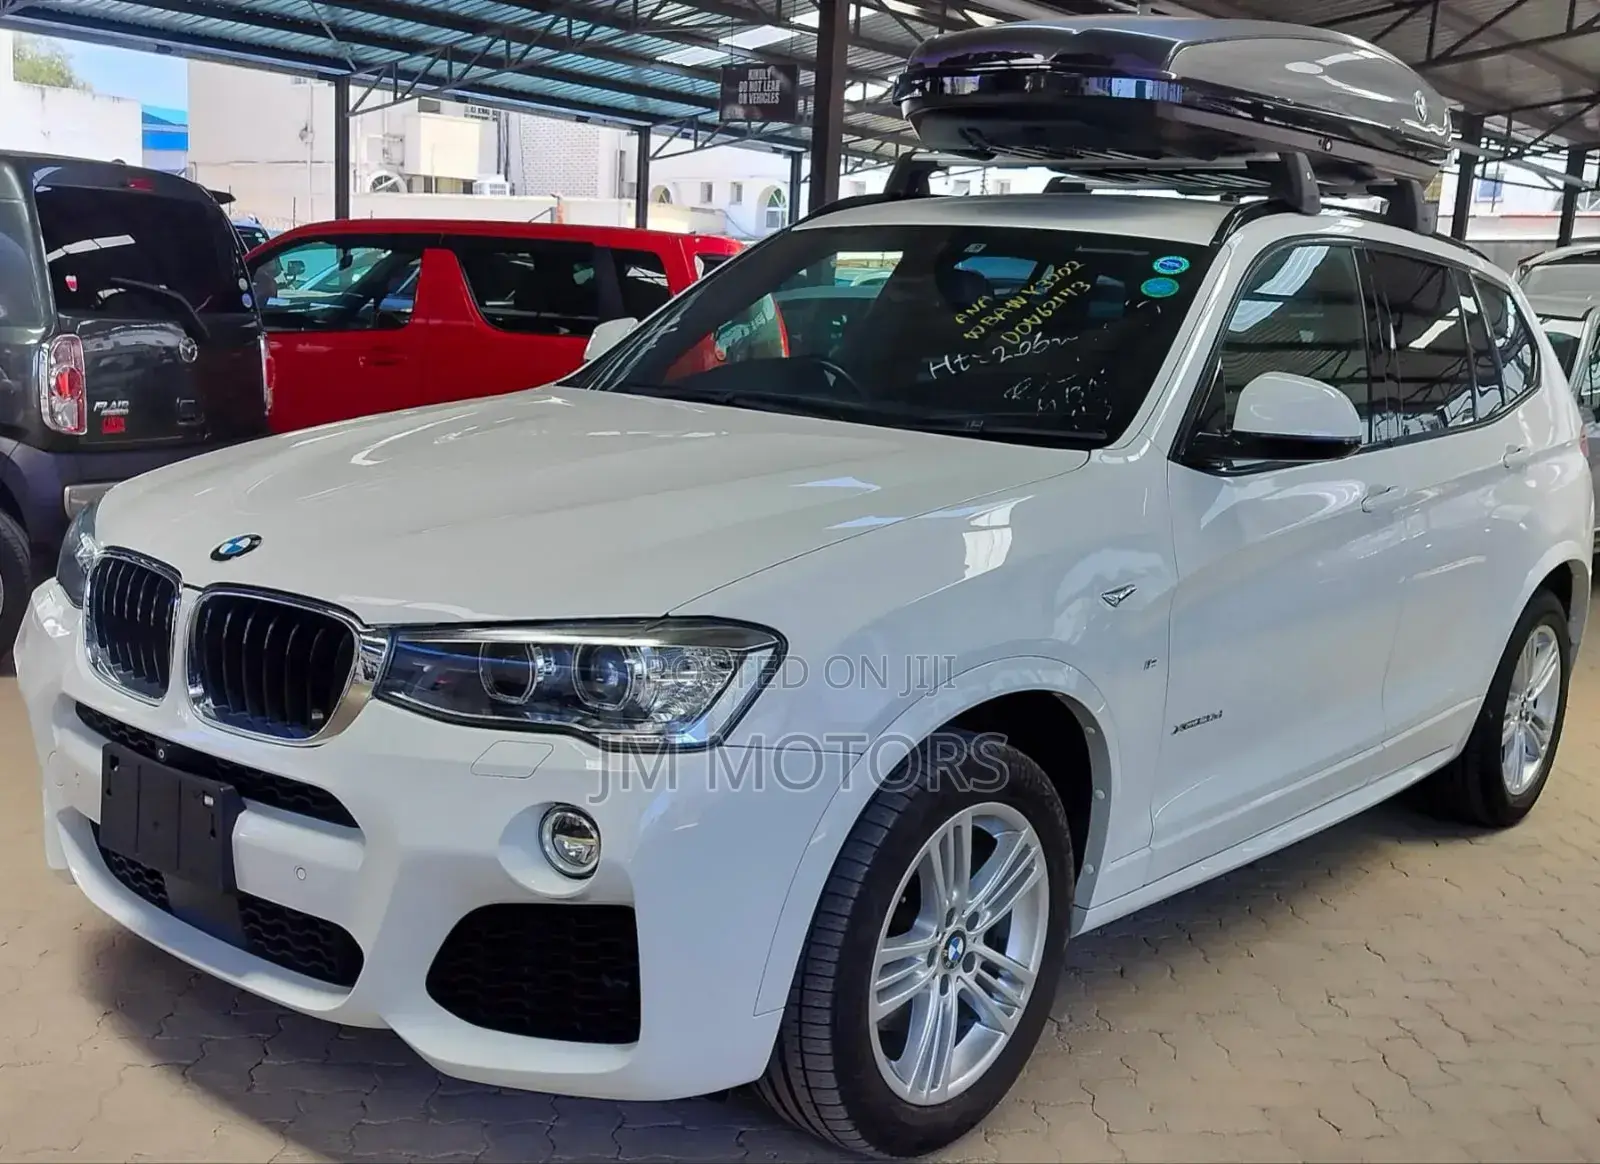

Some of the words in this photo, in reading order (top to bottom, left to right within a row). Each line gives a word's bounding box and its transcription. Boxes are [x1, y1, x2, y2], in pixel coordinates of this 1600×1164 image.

[748, 68, 771, 80] KINDLY
[739, 81, 748, 92] DO
[749, 80, 762, 92] NOT
[749, 92, 780, 104] VEHICLES
